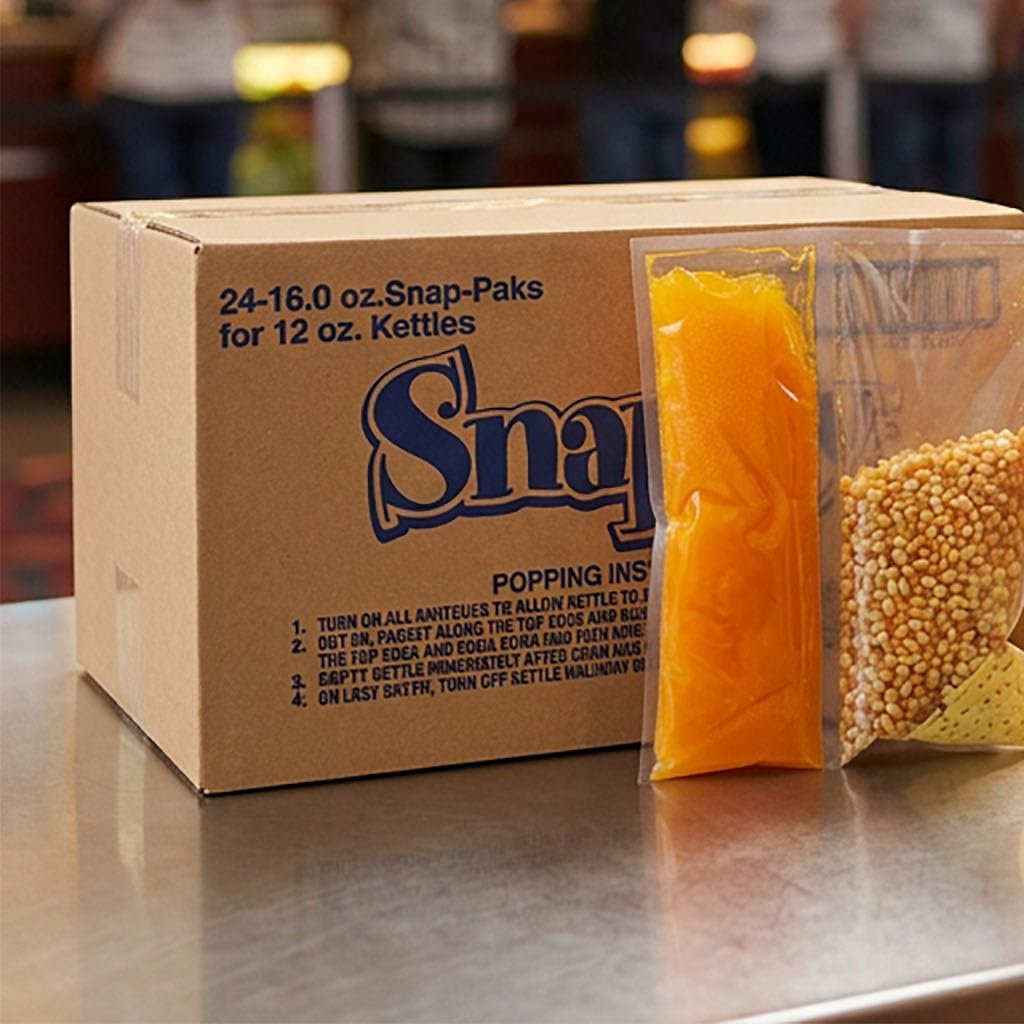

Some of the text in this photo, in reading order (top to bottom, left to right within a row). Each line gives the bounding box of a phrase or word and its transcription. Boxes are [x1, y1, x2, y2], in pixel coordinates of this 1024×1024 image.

[219, 283, 331, 315] 24-16.0
[219, 311, 476, 348] for 12 oz. Kettles
[492, 559, 652, 595] POPPING INS
[292, 620, 306, 634] 1.
[318, 615, 357, 631] TURN
[384, 610, 412, 626] ALL
[292, 639, 306, 653] 2.
[436, 622, 483, 639] ALONG
[424, 642, 453, 658] AND
